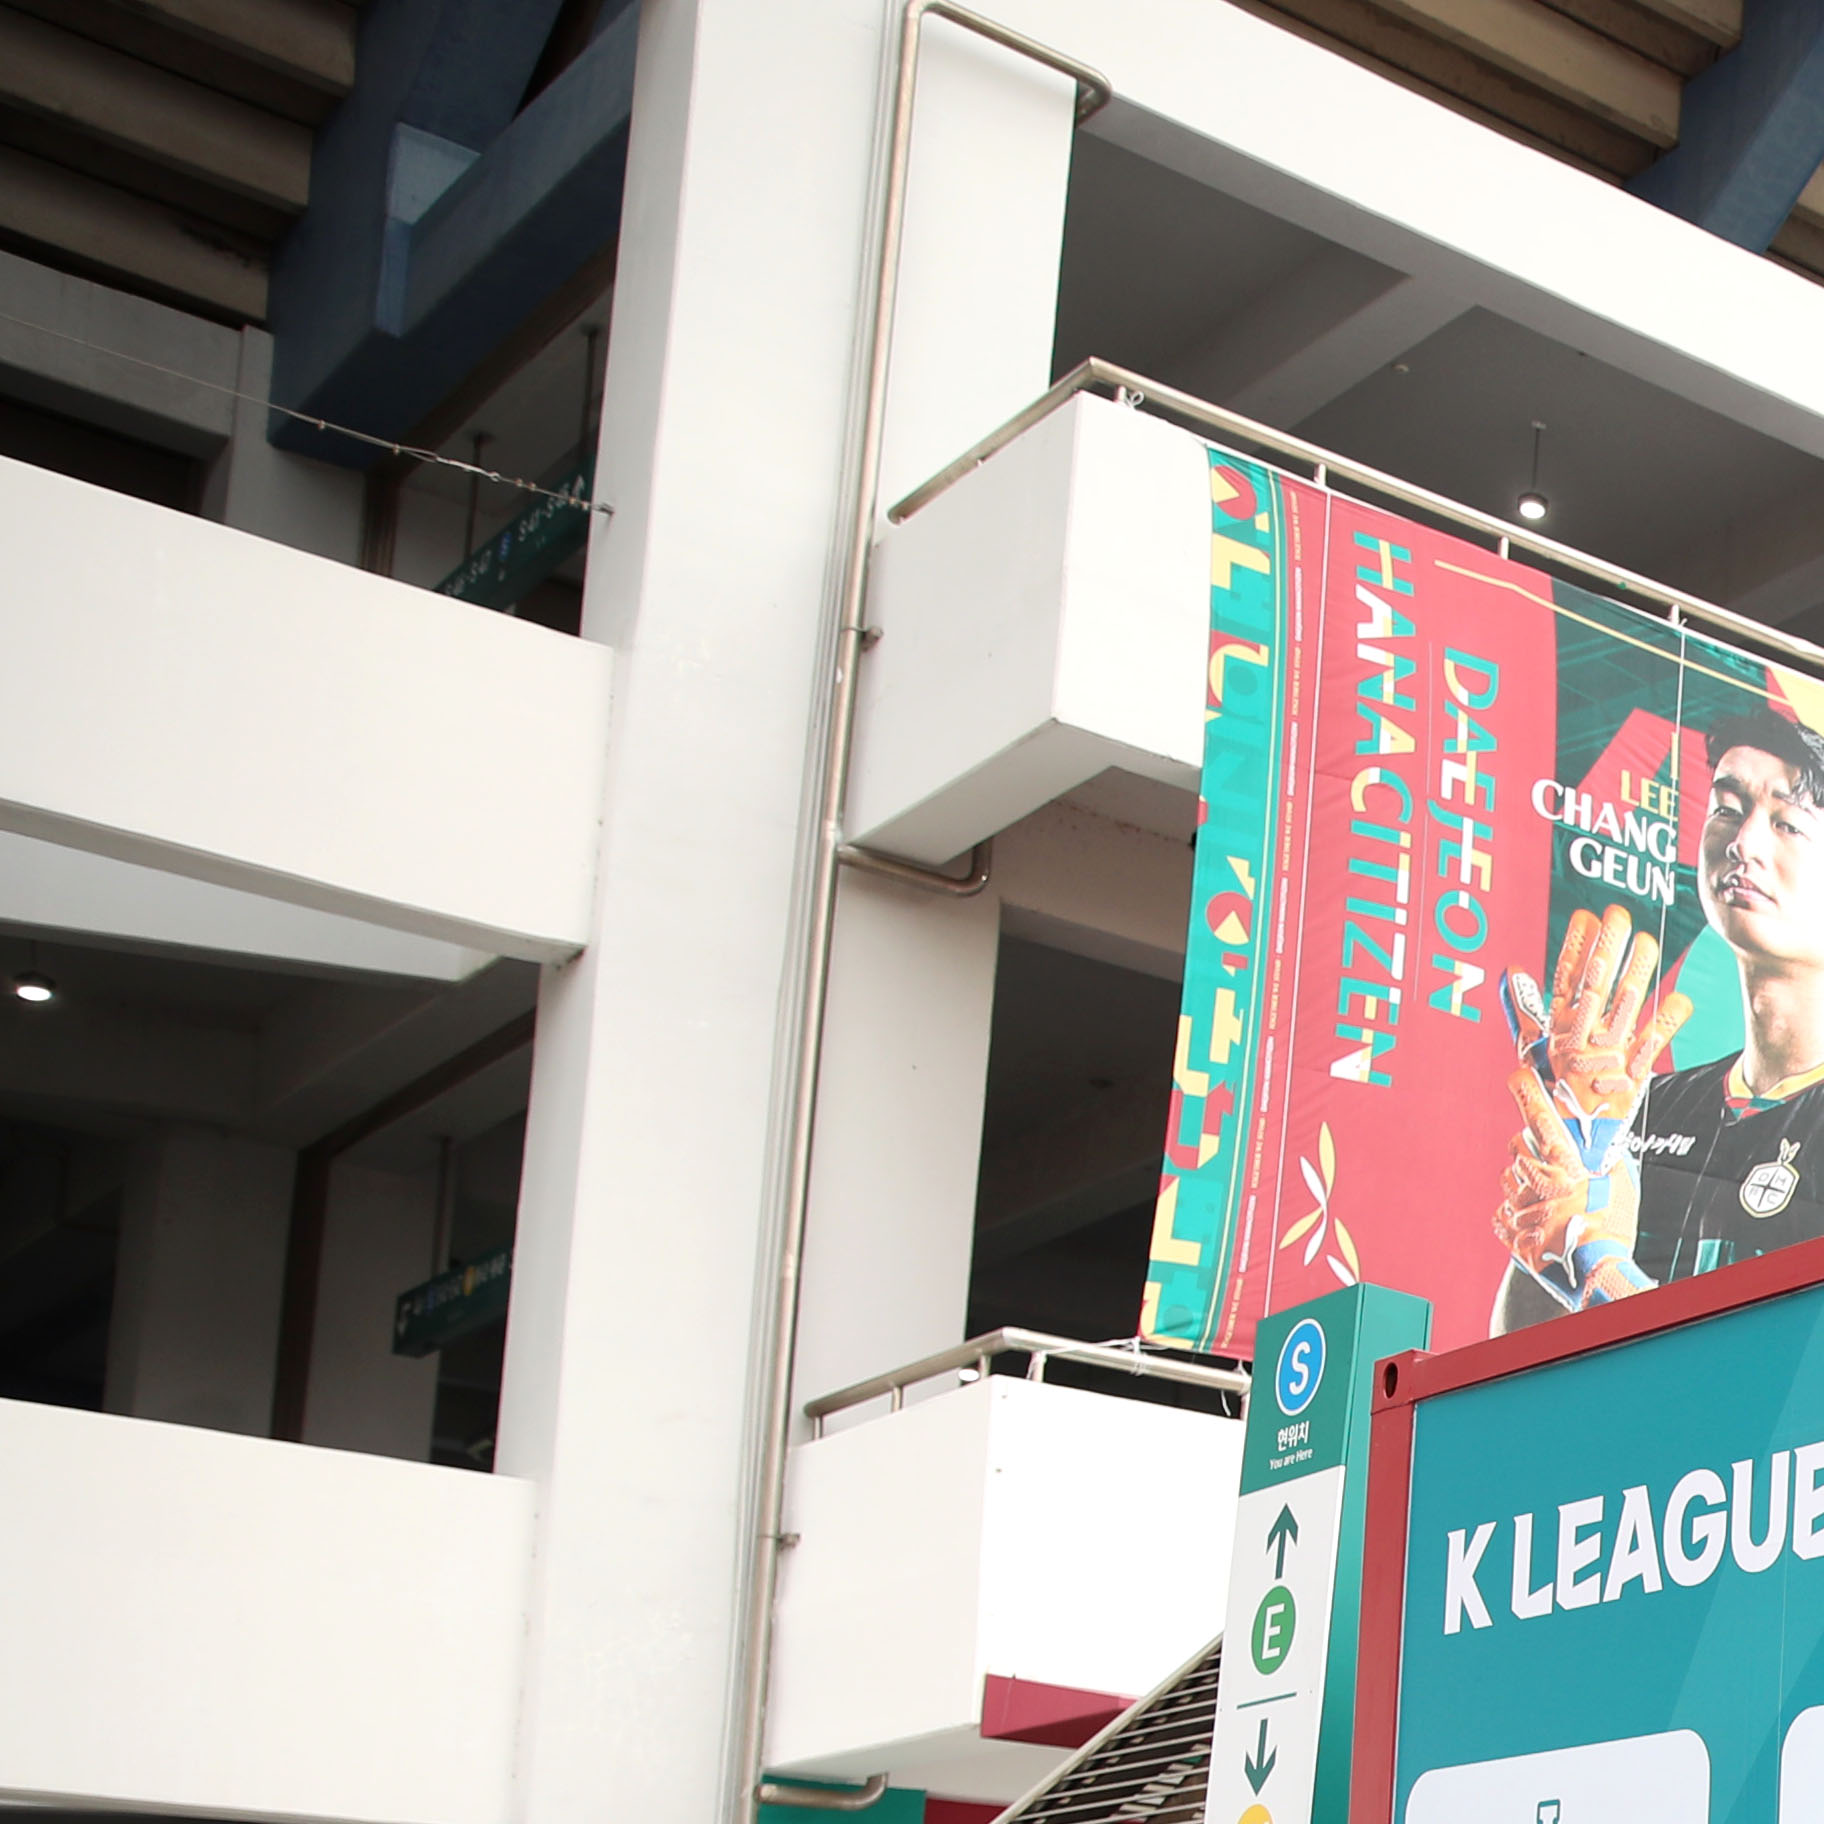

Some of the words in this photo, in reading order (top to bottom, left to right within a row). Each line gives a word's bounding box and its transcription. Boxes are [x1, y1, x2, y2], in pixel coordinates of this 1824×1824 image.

[1330, 531, 1414, 1088] HANACITIZEN
[1532, 778, 1678, 865] CHANG
[1620, 769, 1679, 817] LEE
[1430, 648, 1498, 1023] DAEJEON
[1569, 838, 1676, 907] GEUN
[1289, 1341, 1311, 1395] S
[1269, 1458, 1283, 1470] You
[1284, 1453, 1295, 1465] are
[1296, 1448, 1313, 1462] Here
[1277, 1420, 1310, 1451] 현위치
[1443, 1528, 1496, 1636] K
[1259, 1602, 1288, 1660] E
